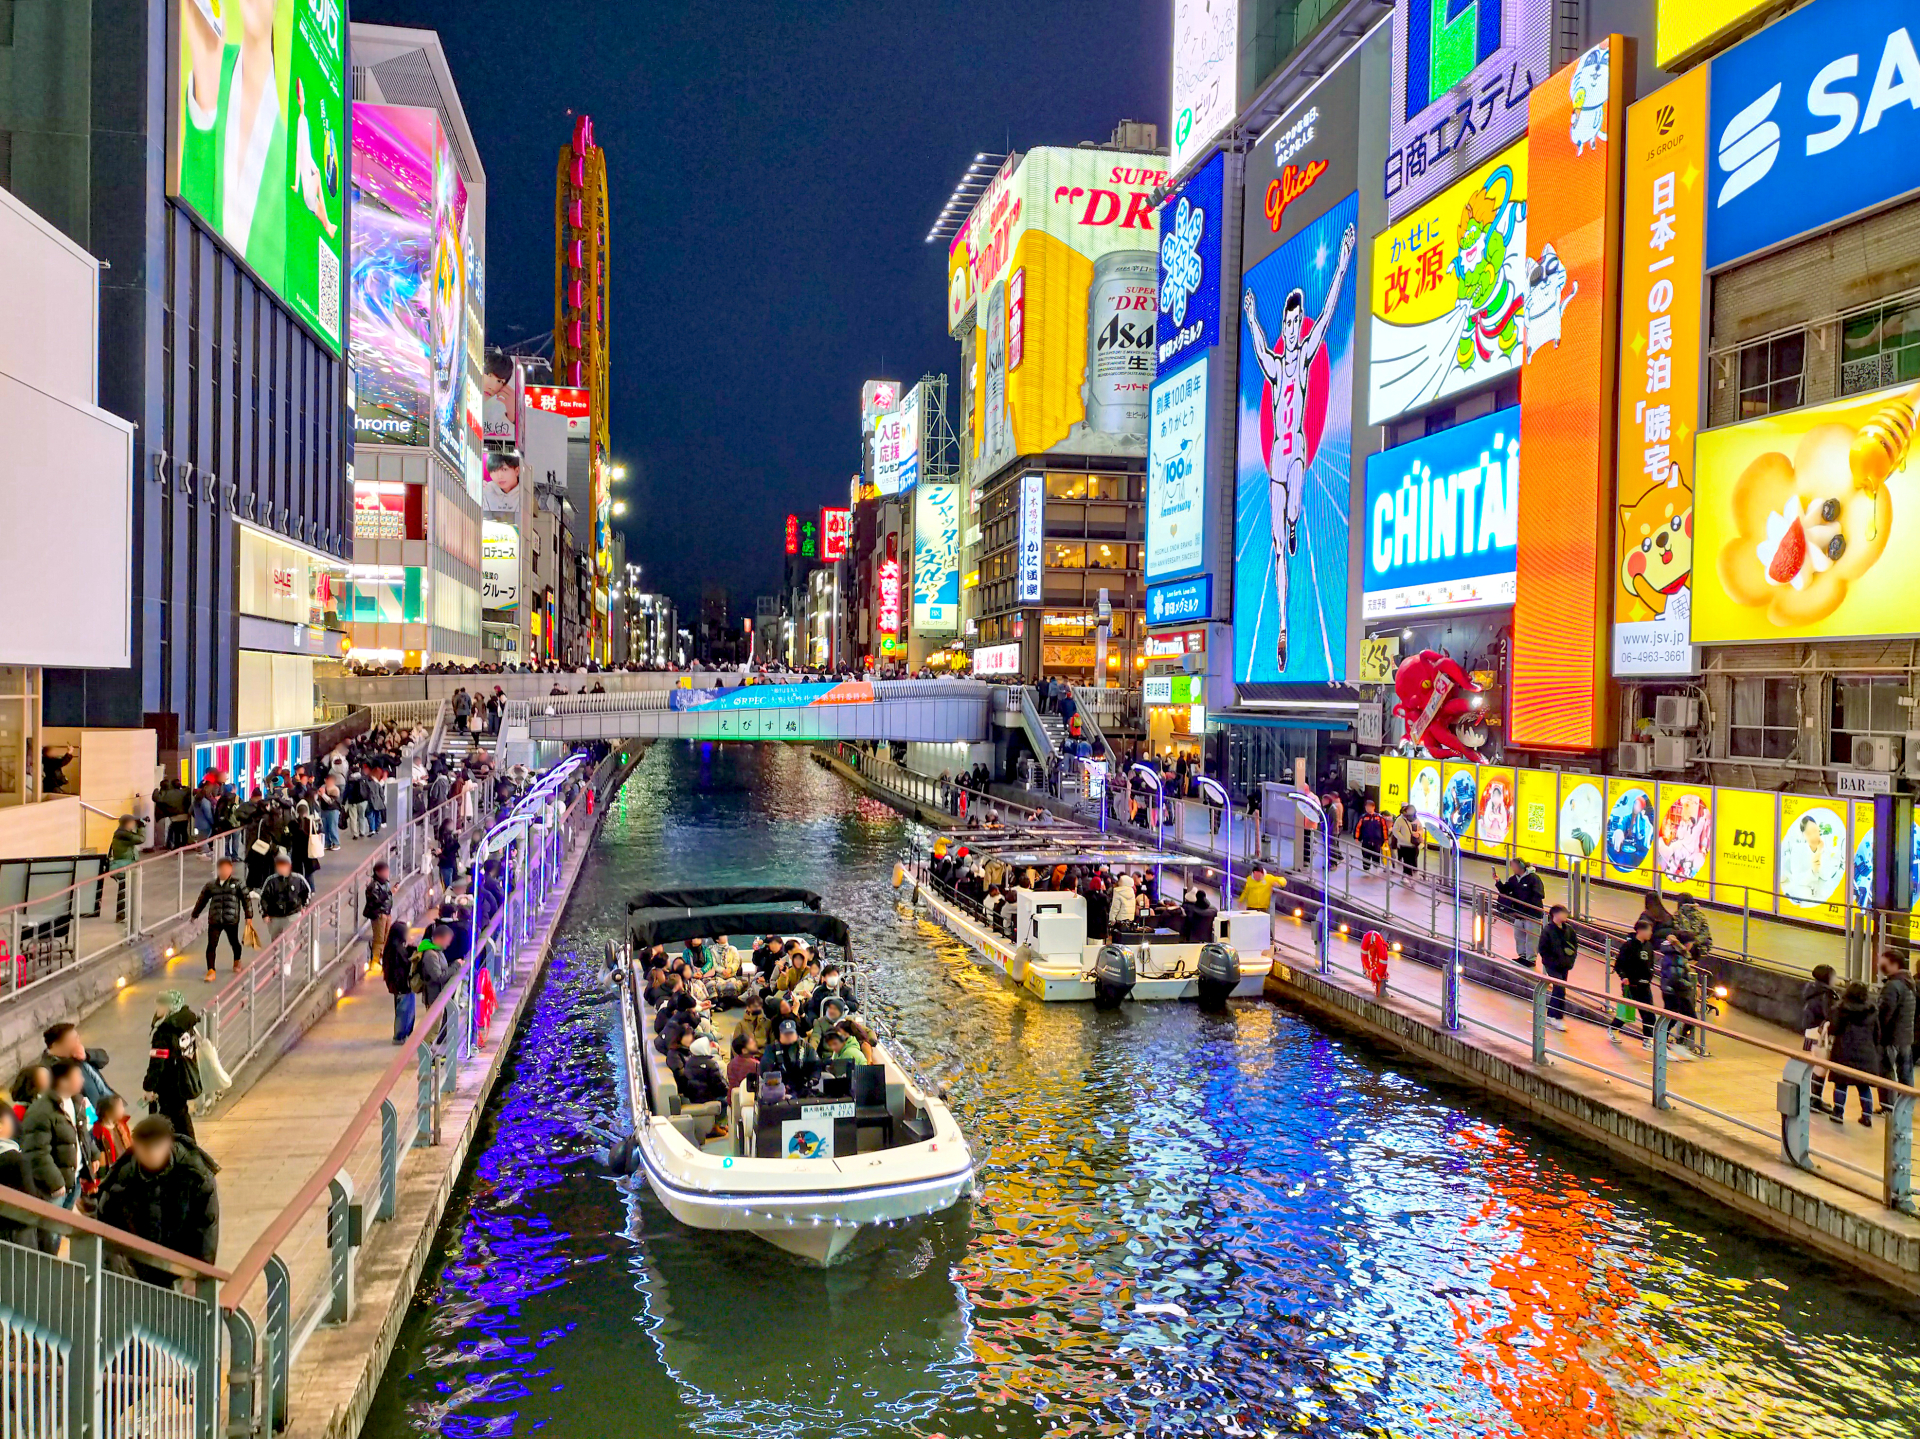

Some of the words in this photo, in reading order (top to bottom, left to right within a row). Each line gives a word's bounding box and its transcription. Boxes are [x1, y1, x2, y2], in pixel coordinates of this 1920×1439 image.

[1194, 76, 1221, 126] ピップ
[1806, 26, 1920, 157] SA
[1384, 61, 1534, 200] 日商エステム
[1646, 150, 1655, 162] JS
[1656, 134, 1684, 156] GROUP
[1265, 159, 1329, 233] Glico
[1390, 217, 1440, 264] かぜに
[1384, 240, 1445, 315] 改源
[1128, 355, 1148, 371] 生
[1114, 383, 1149, 392] スーパード
[1156, 375, 1202, 417] 創業100周年
[1160, 406, 1195, 439] ありがとう
[1283, 378, 1296, 456] グリコ
[880, 421, 900, 443] 入店
[879, 441, 900, 463] 応援
[1372, 437, 1520, 573] CHINTAI
[273, 568, 292, 588] SALE
[483, 582, 516, 600] グループ
[879, 561, 899, 631] 大阪王将
[1165, 597, 1199, 616] 雪印メグミルク
[1623, 630, 1684, 646] www.jsv.jp
[1500, 639, 1506, 671] 2F
[1621, 650, 1685, 663] 06-4963-3661
[721, 719, 797, 732] えびす橋
[1840, 777, 1865, 791] BAR
[1723, 851, 1766, 865] mikkeLIVE
